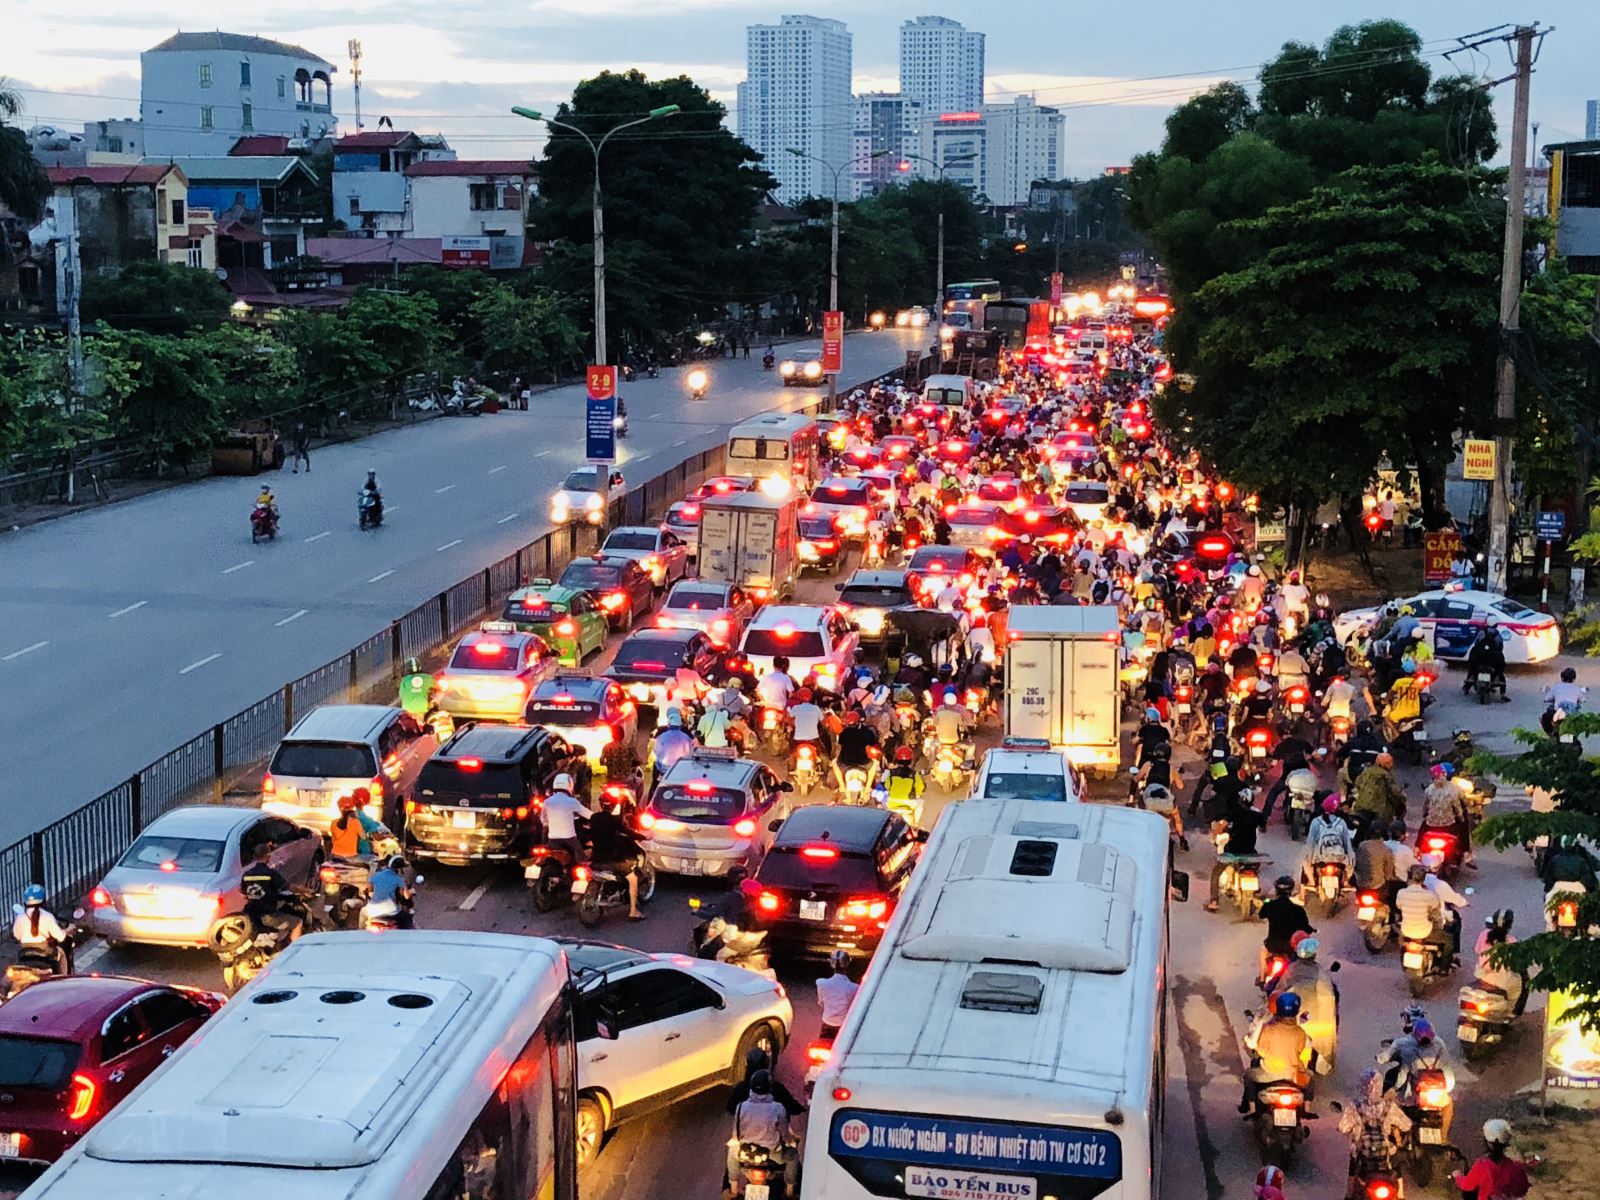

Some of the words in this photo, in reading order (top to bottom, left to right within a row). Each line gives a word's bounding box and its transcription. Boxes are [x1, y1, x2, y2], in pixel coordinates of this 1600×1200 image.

[872, 1126, 886, 1148] BX
[888, 1122, 914, 1150] NƯỚC
[956, 1133, 968, 1154] BV
[971, 1131, 997, 1160] BỆNH
[999, 1134, 1027, 1164] NHIỆT
[1030, 1134, 1046, 1161] ĐỚI
[1050, 1140, 1065, 1162] TW
[1067, 1141, 1082, 1164] CƠ
[1083, 1136, 1098, 1165] SỞ
[1099, 1145, 1106, 1166] 2
[941, 1189, 960, 1197] 024
[954, 1176, 990, 1191] YẾN
[996, 1182, 1030, 1195] BUS
